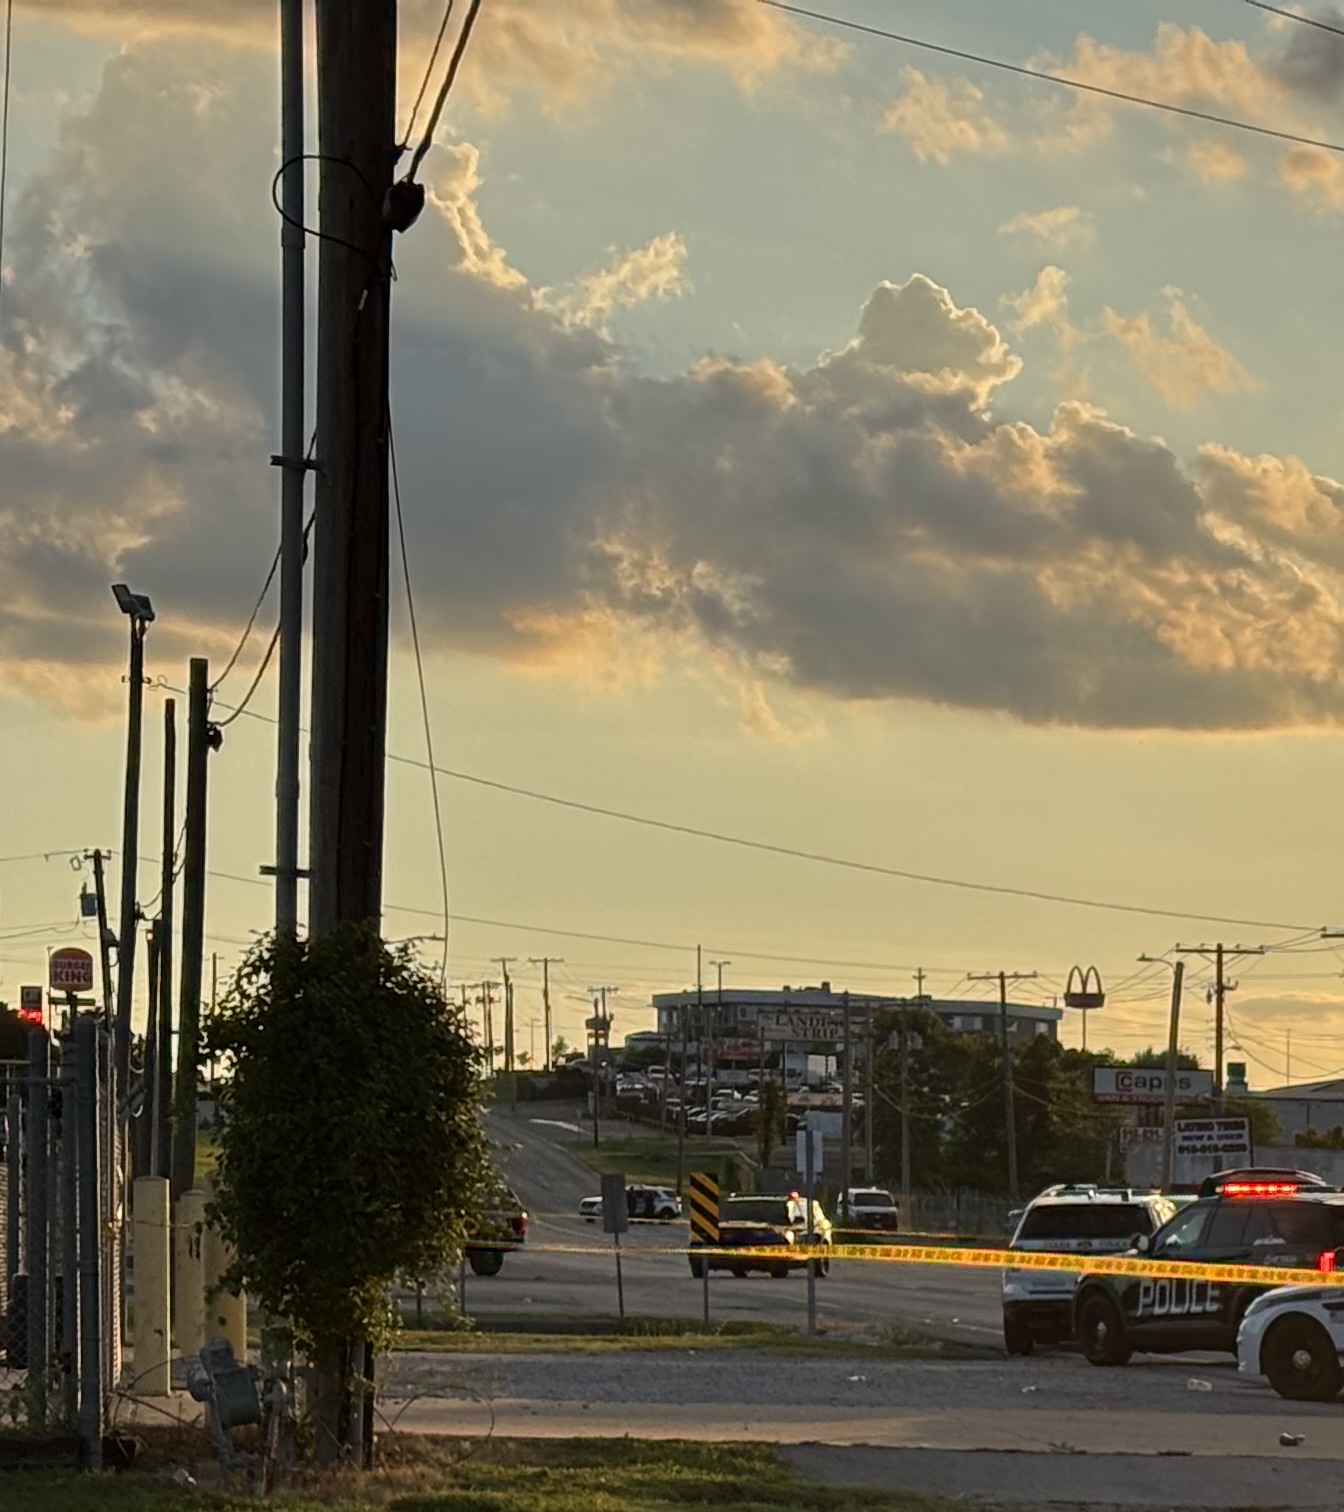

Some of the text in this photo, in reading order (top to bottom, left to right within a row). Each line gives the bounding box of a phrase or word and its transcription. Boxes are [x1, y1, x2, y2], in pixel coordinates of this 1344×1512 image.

[54, 970, 91, 983] KING
[775, 1014, 845, 1028] LANDI
[792, 1027, 839, 1039] STRIP
[1136, 1278, 1223, 1317] POLICE
